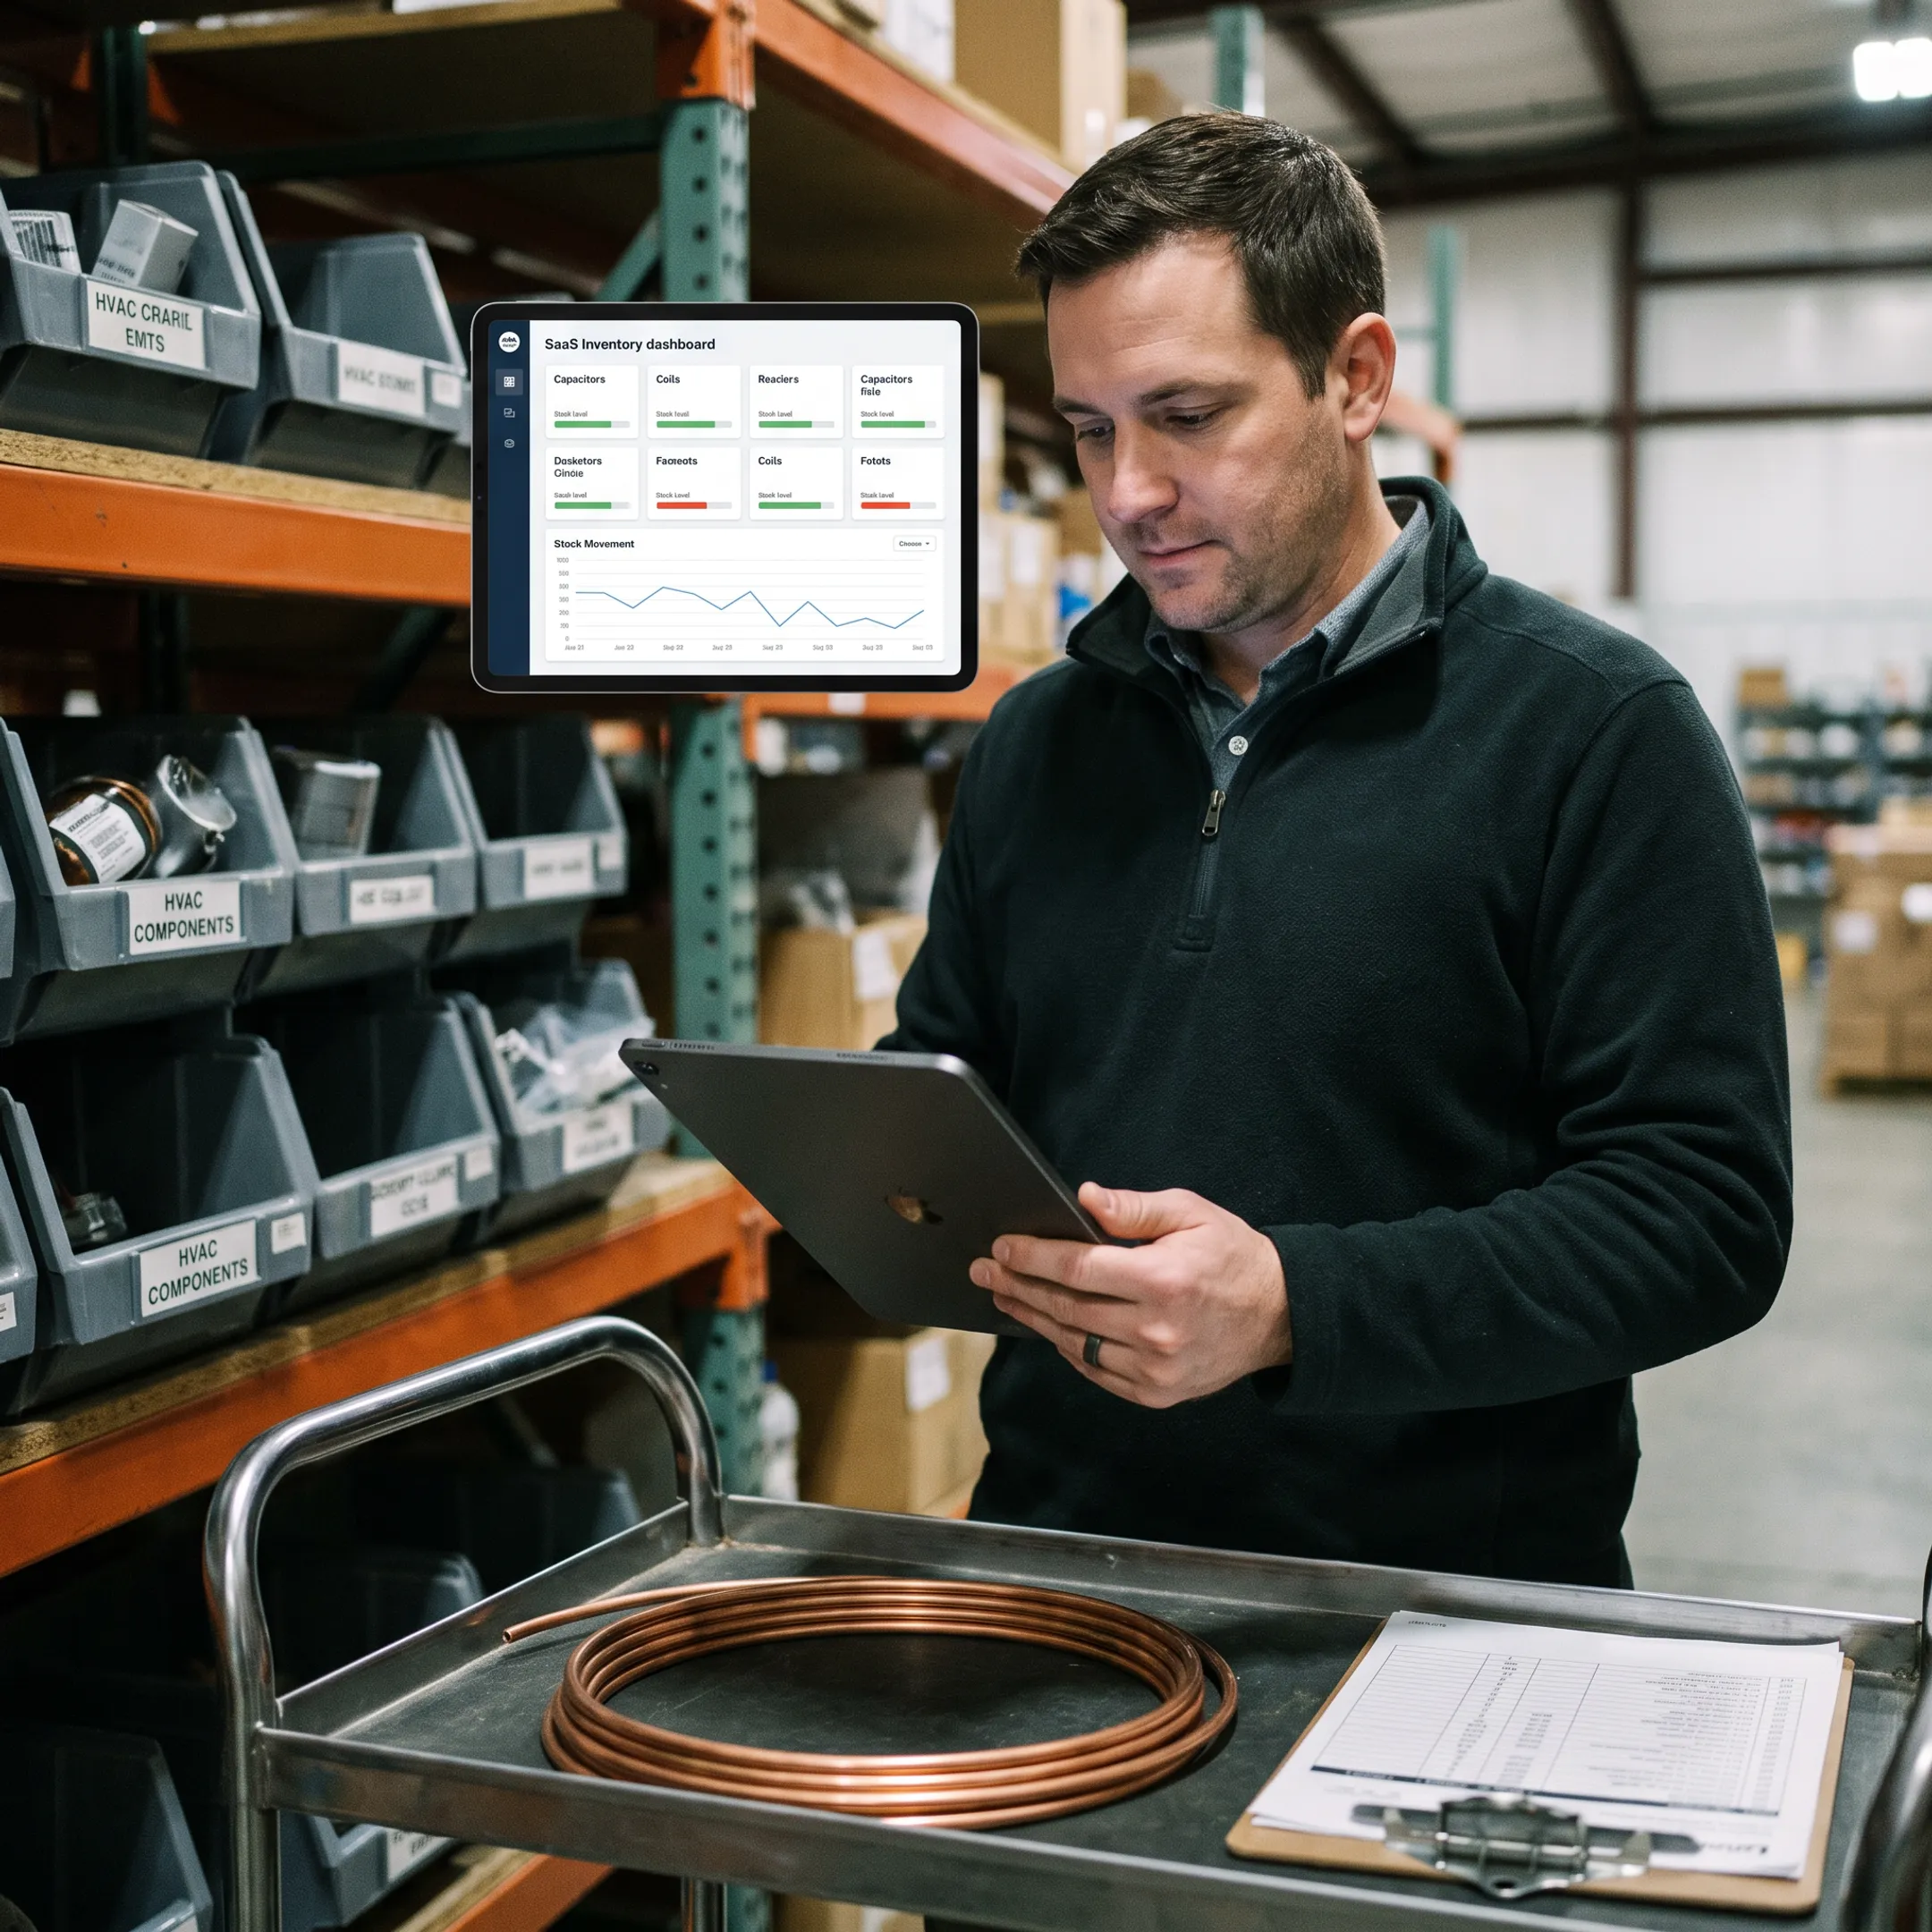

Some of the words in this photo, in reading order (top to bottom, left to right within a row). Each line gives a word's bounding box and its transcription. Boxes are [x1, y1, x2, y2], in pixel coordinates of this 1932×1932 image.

[96, 292, 137, 318] HVAC
[125, 327, 165, 352] EMTS
[545, 338, 579, 350] SaaS
[582, 338, 643, 353] Inventory
[646, 338, 716, 350] dashboard
[554, 374, 606, 386] Capacitors
[656, 374, 681, 384] Coils
[860, 374, 913, 386] Capacitors
[758, 456, 783, 465] Coils
[860, 456, 892, 465] Fotots
[554, 539, 581, 548] Stock
[584, 539, 635, 548] Movement
[165, 892, 203, 911] HVAC
[134, 917, 234, 943] COMPONENTS
[179, 1240, 217, 1267] HVAC
[148, 1258, 248, 1305] COMPONENTS
